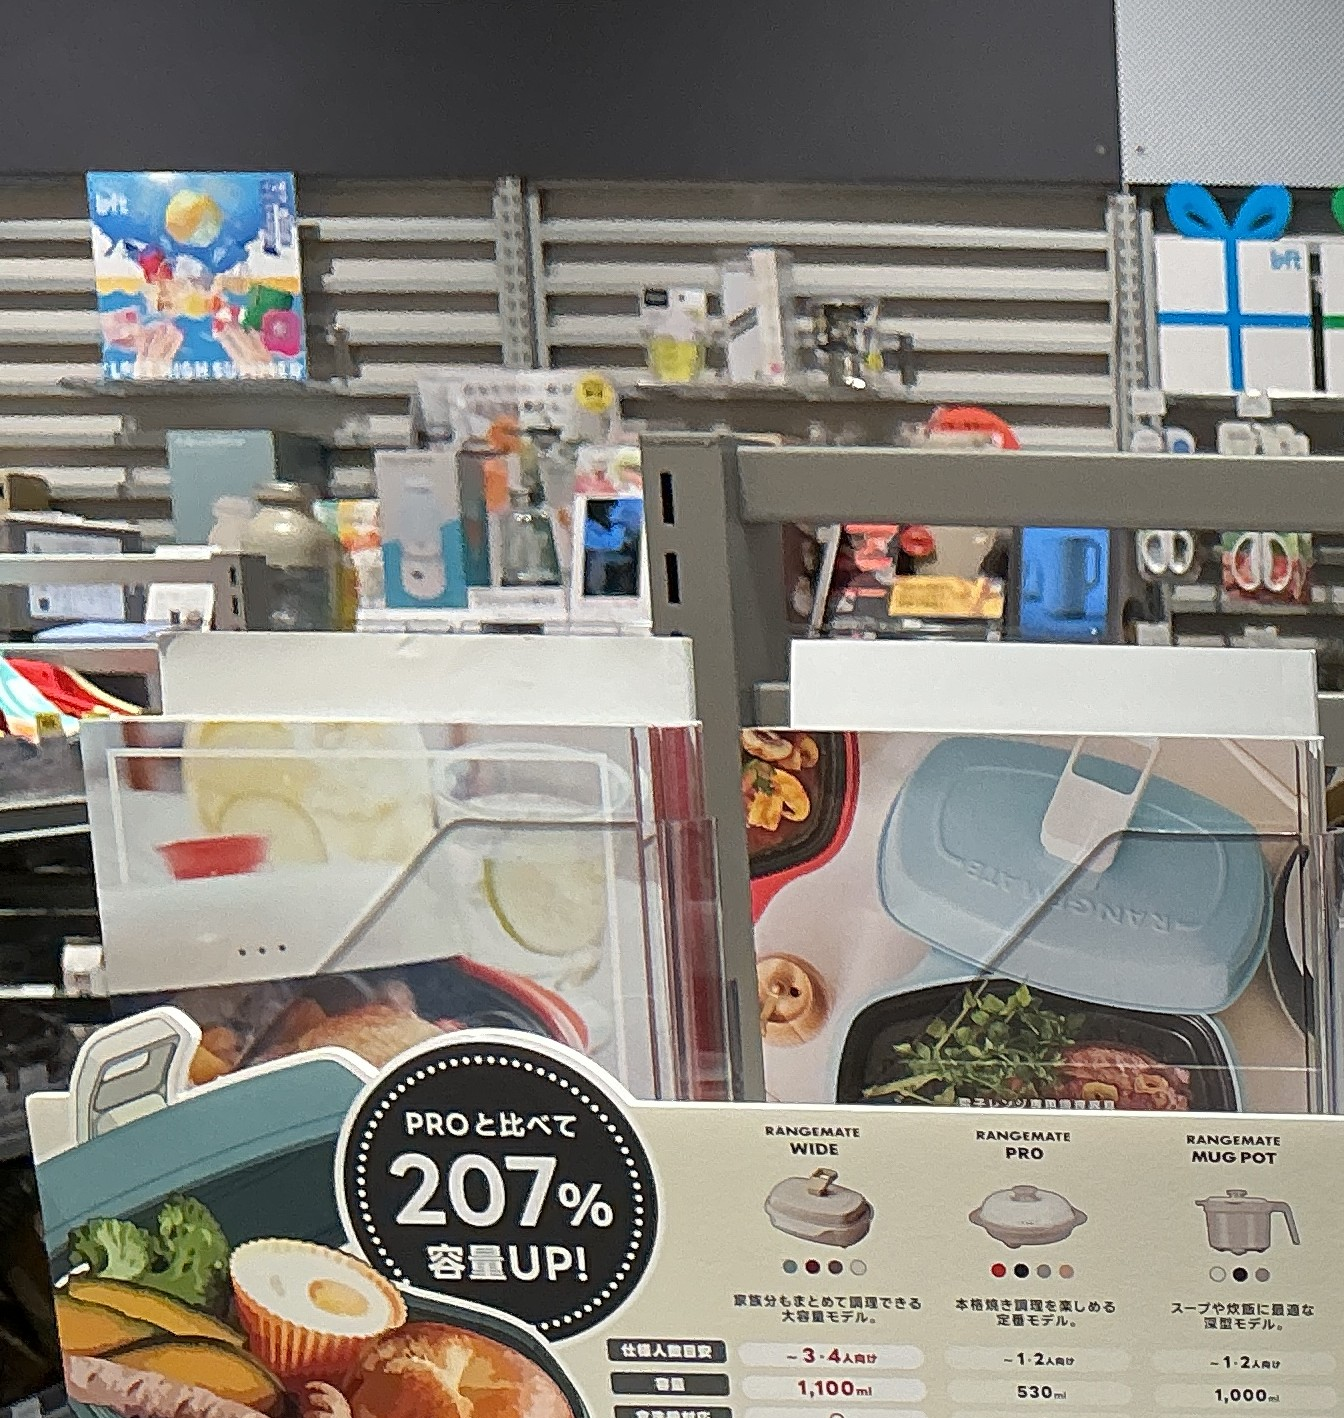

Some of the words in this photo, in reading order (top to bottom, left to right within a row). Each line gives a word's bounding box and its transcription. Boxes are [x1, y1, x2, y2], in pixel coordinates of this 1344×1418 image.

[764, 1125, 861, 1139] RANGEMATE
[975, 1130, 1072, 1143] RANGEMATE
[1186, 1134, 1282, 1147] RANGEMATE
[789, 1141, 840, 1157] WIDE
[1004, 1146, 1045, 1161] PRO
[1191, 1150, 1237, 1164] MUG
[1240, 1150, 1278, 1165] POT
[388, 1152, 614, 1229] 207%
